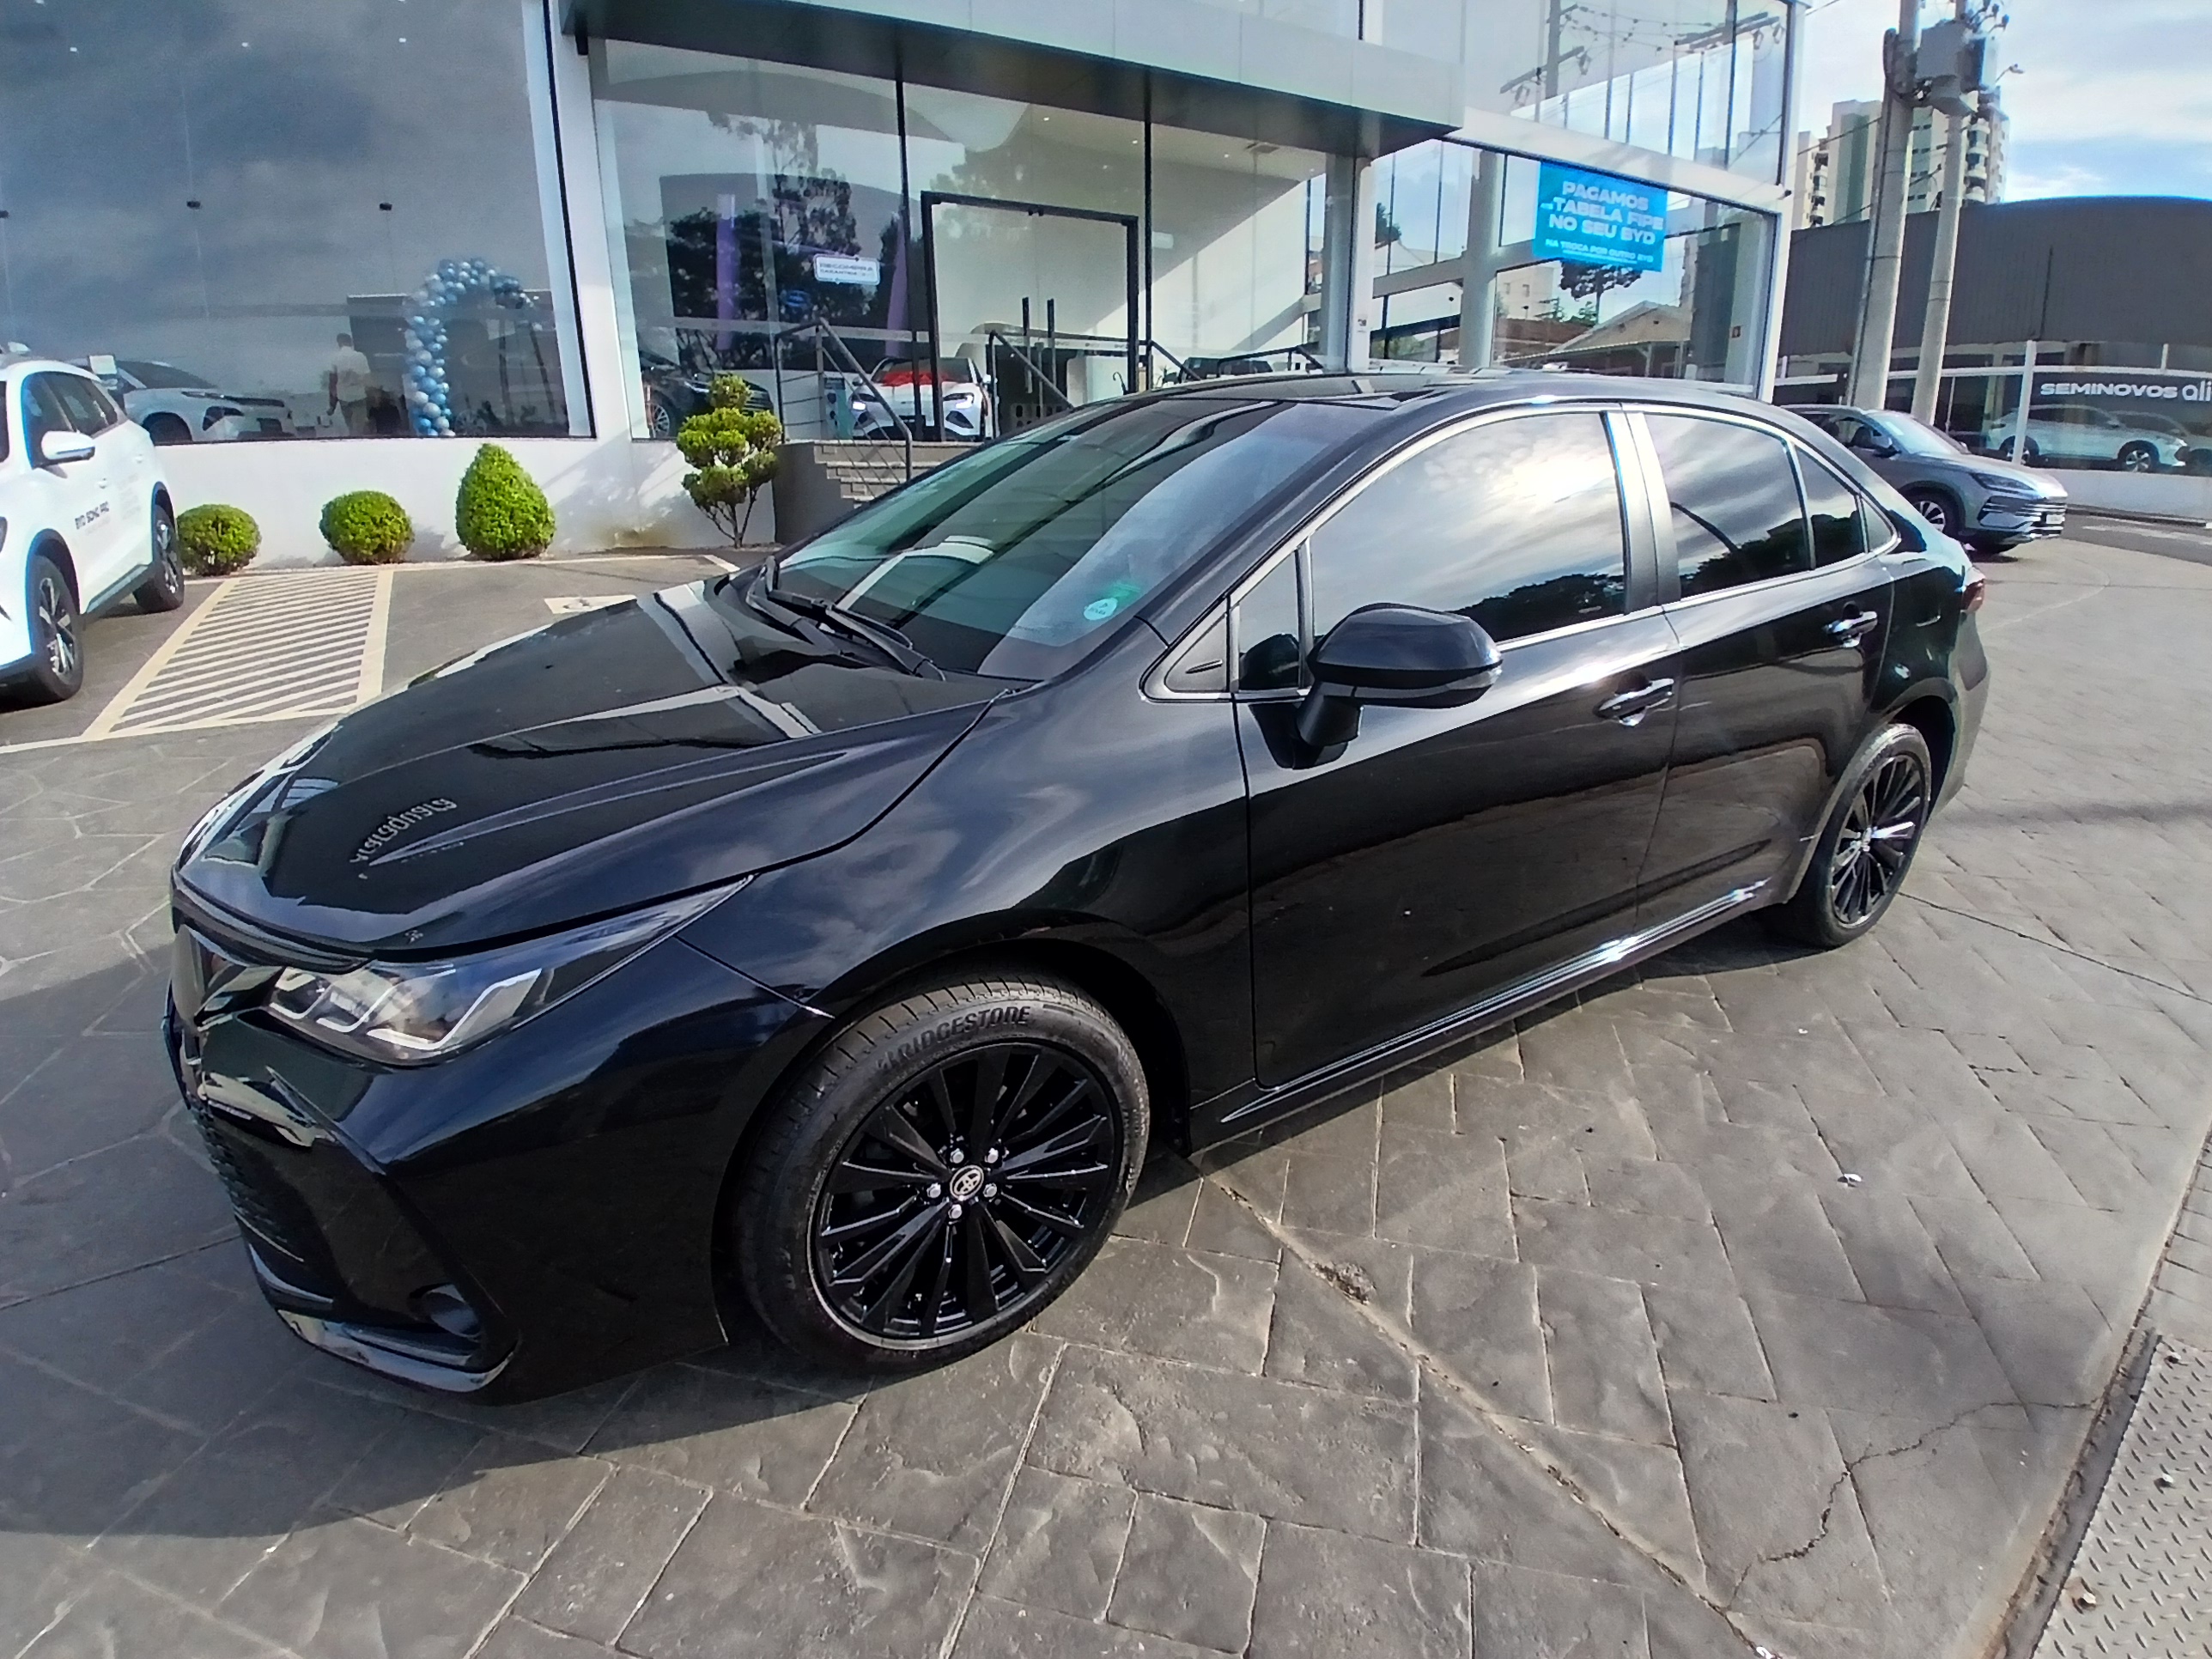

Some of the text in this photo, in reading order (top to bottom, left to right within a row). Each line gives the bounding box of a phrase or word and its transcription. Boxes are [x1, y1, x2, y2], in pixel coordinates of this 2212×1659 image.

[1562, 181, 1649, 211] PAGAMOS
[1553, 197, 1664, 230] TABELA FIPE
[1549, 214, 1656, 245] NO SEU BYD
[1560, 240, 1589, 252] TROCA
[2040, 383, 2178, 398] SEMINOVOS
